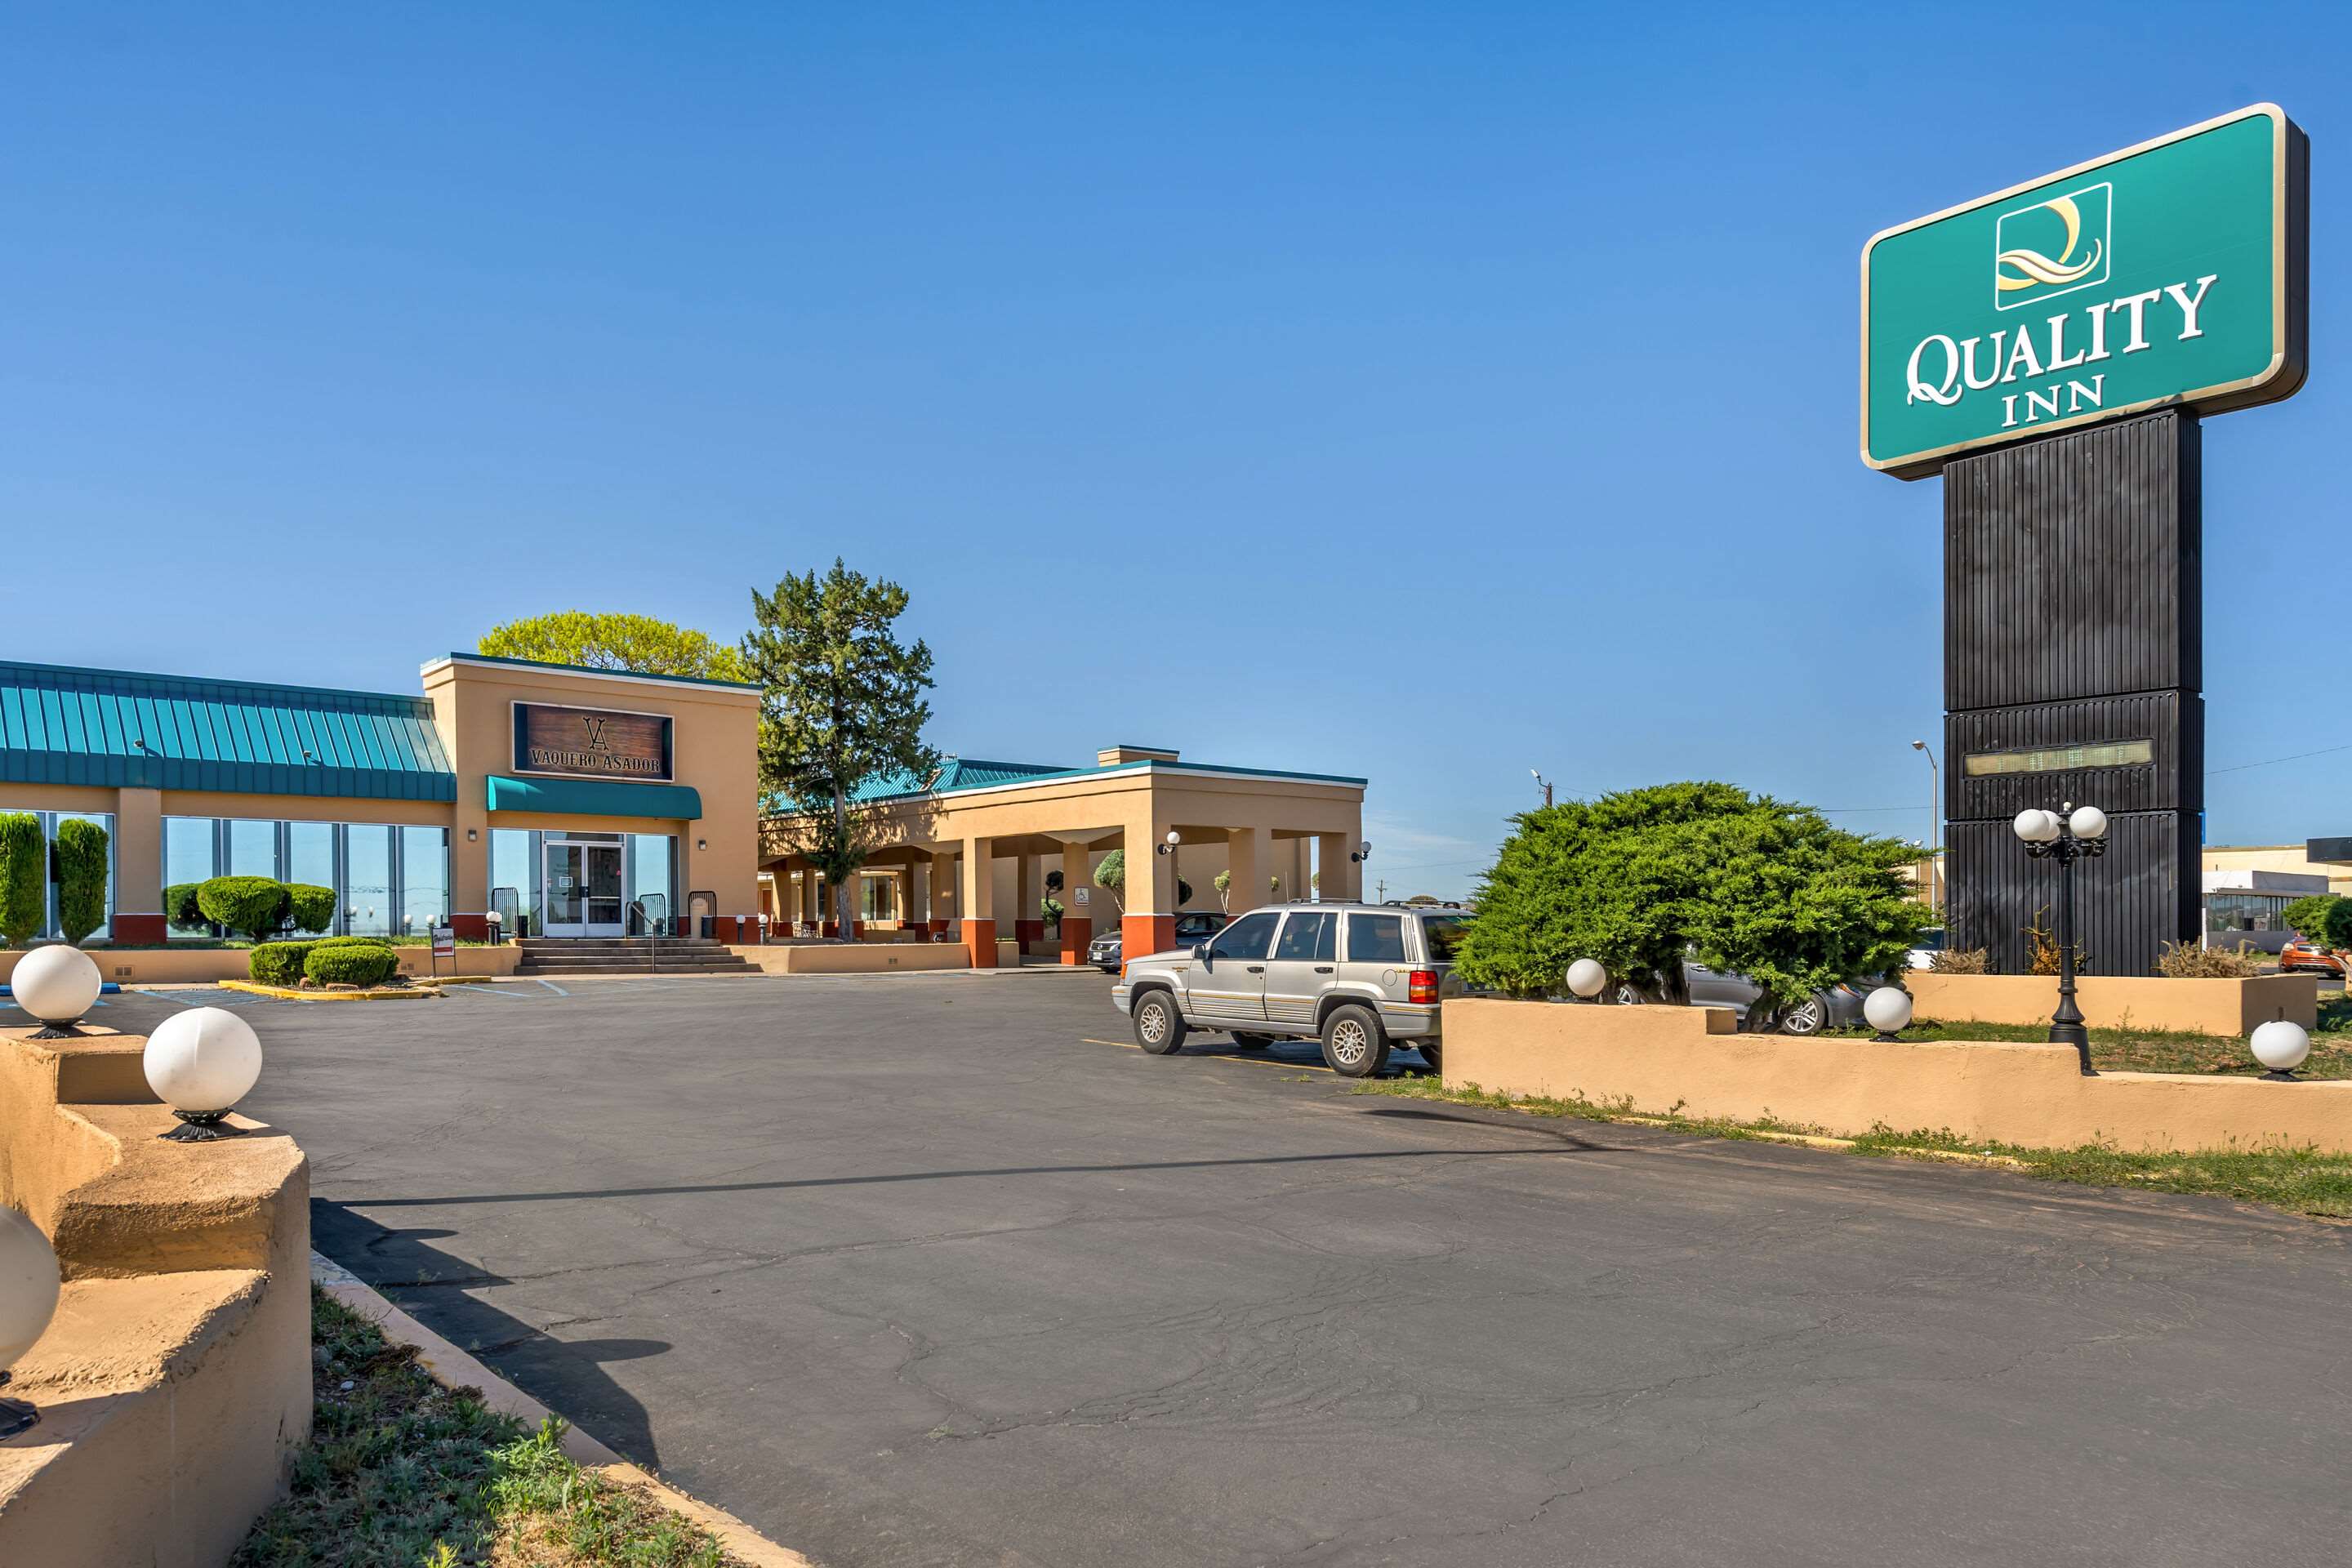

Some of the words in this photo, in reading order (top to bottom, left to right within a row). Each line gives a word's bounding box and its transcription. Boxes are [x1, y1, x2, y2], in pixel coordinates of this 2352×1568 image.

[1906, 274, 2217, 407] QUALITY
[2001, 374, 2105, 428] INN
[531, 750, 596, 767] VAQUERO
[603, 755, 660, 772] ASADOR
